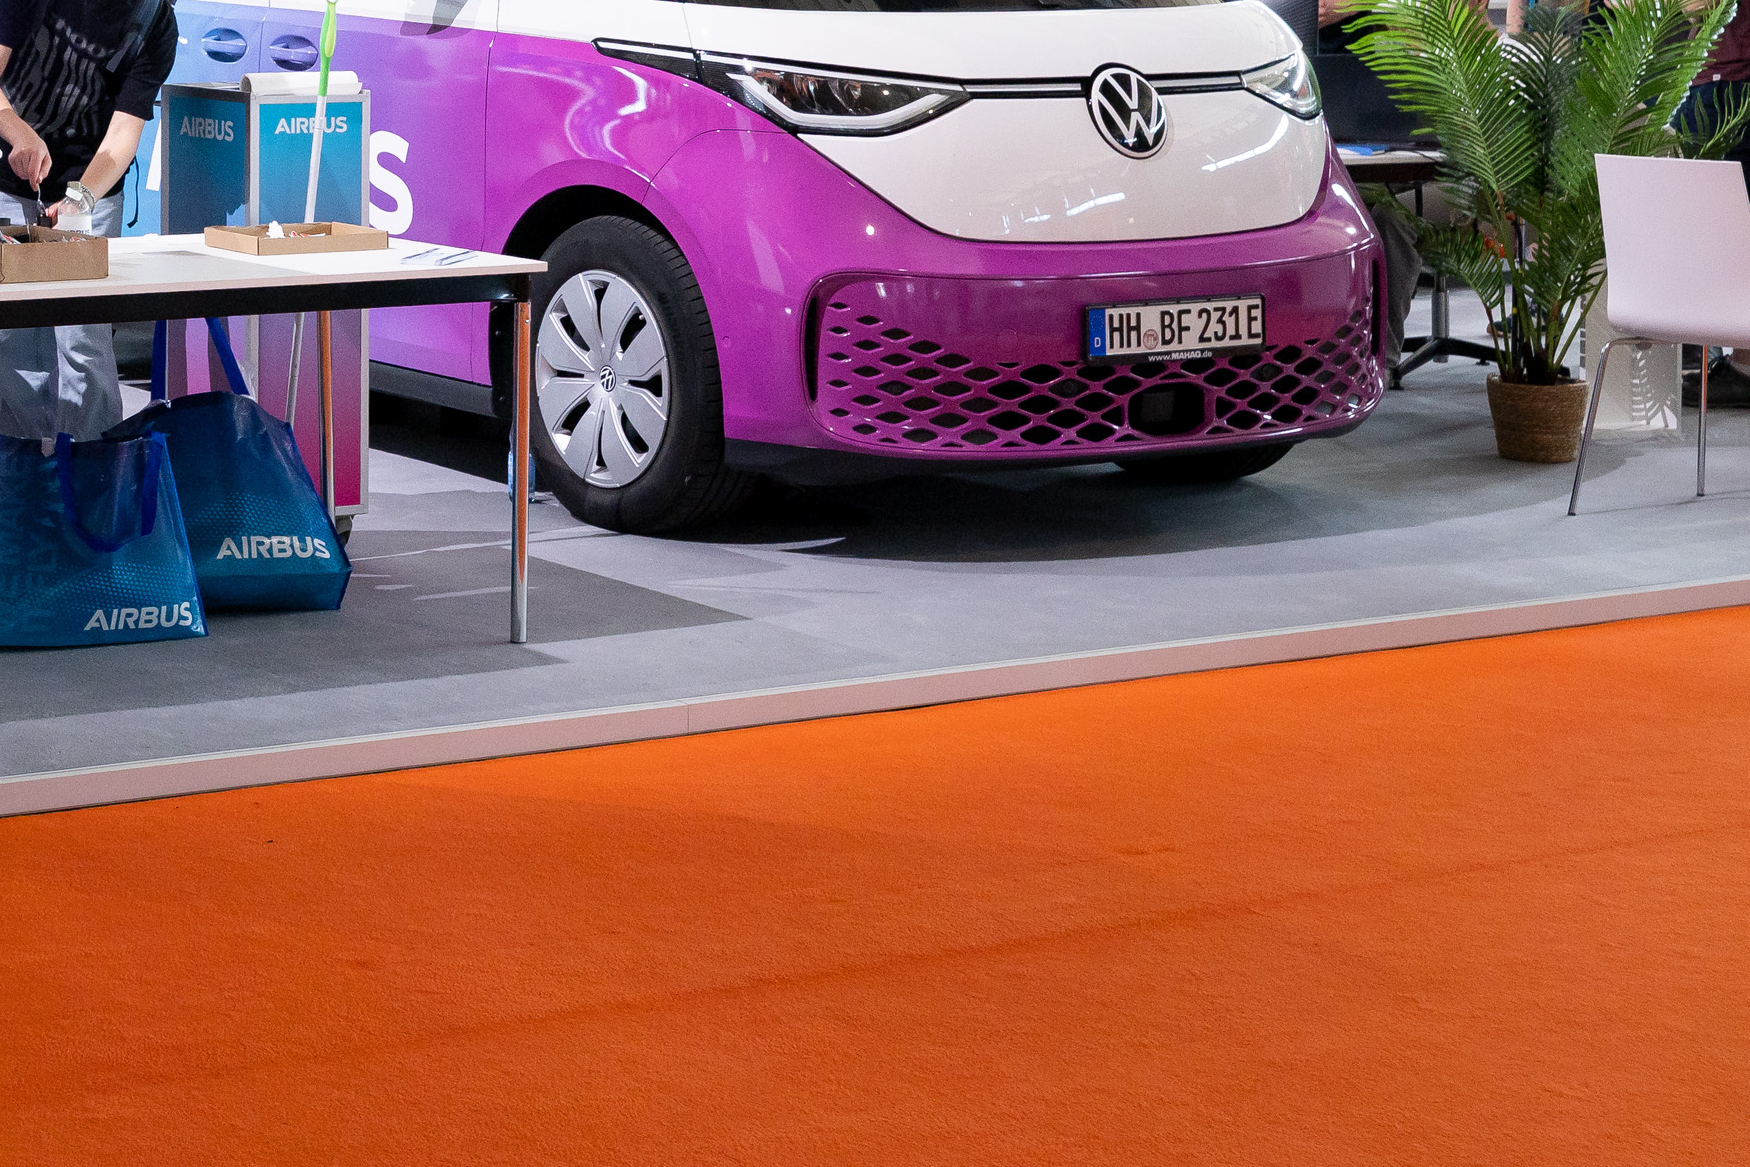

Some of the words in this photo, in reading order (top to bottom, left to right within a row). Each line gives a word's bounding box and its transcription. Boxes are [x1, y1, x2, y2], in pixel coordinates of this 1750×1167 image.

[180, 116, 234, 142] AIRBUS
[1094, 337, 1101, 347] D
[1109, 312, 1141, 349] HH
[1160, 309, 1191, 345] BF
[216, 535, 331, 561] AIRBUS
[84, 601, 193, 631] AIRBUS
